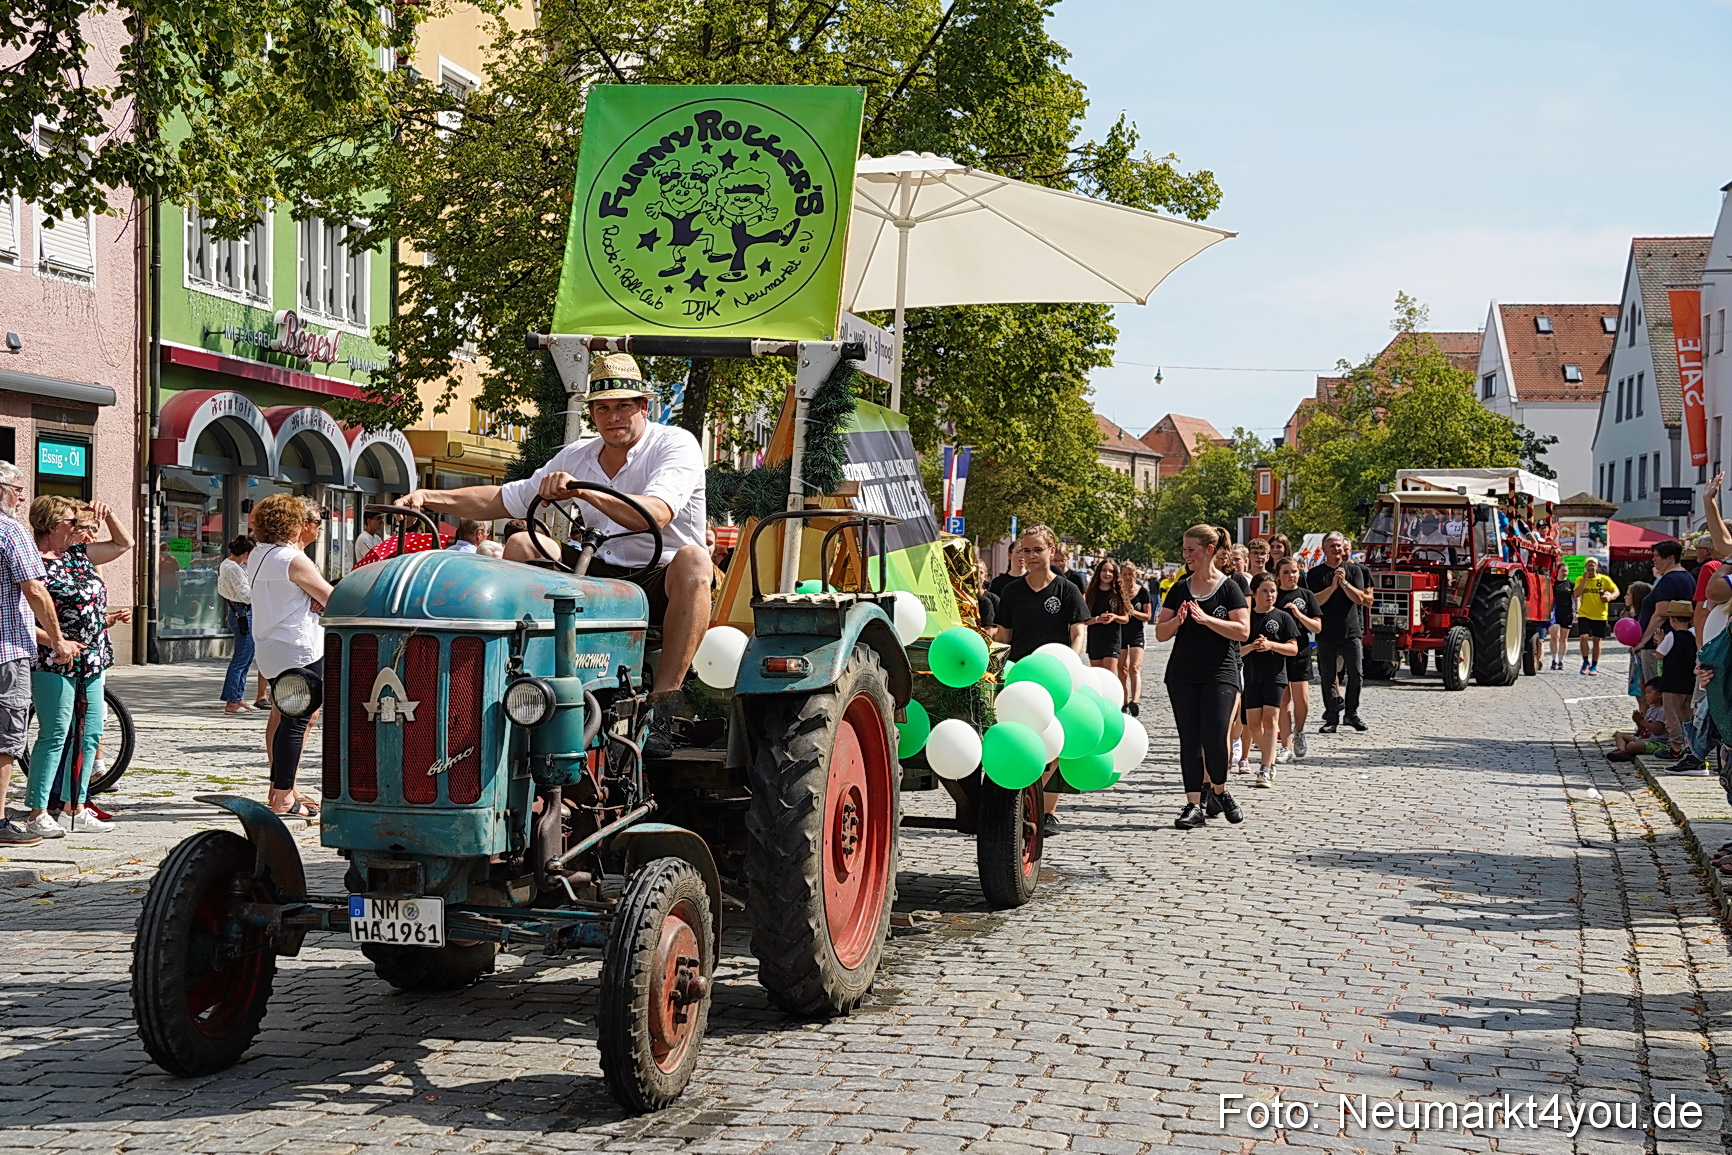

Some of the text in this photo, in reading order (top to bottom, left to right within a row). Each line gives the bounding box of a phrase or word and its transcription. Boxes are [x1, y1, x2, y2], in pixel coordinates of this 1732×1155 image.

[681, 299, 721, 321] DJK
[733, 260, 802, 309] Neumarkt
[224, 323, 271, 349] METZGEREI
[273, 309, 341, 366] Bögerl
[839, 322, 849, 341] oll
[1677, 338, 1706, 408] SALE
[41, 448, 80, 469] Essig Öl
[372, 898, 399, 920] NM
[386, 921, 441, 943] 1961
